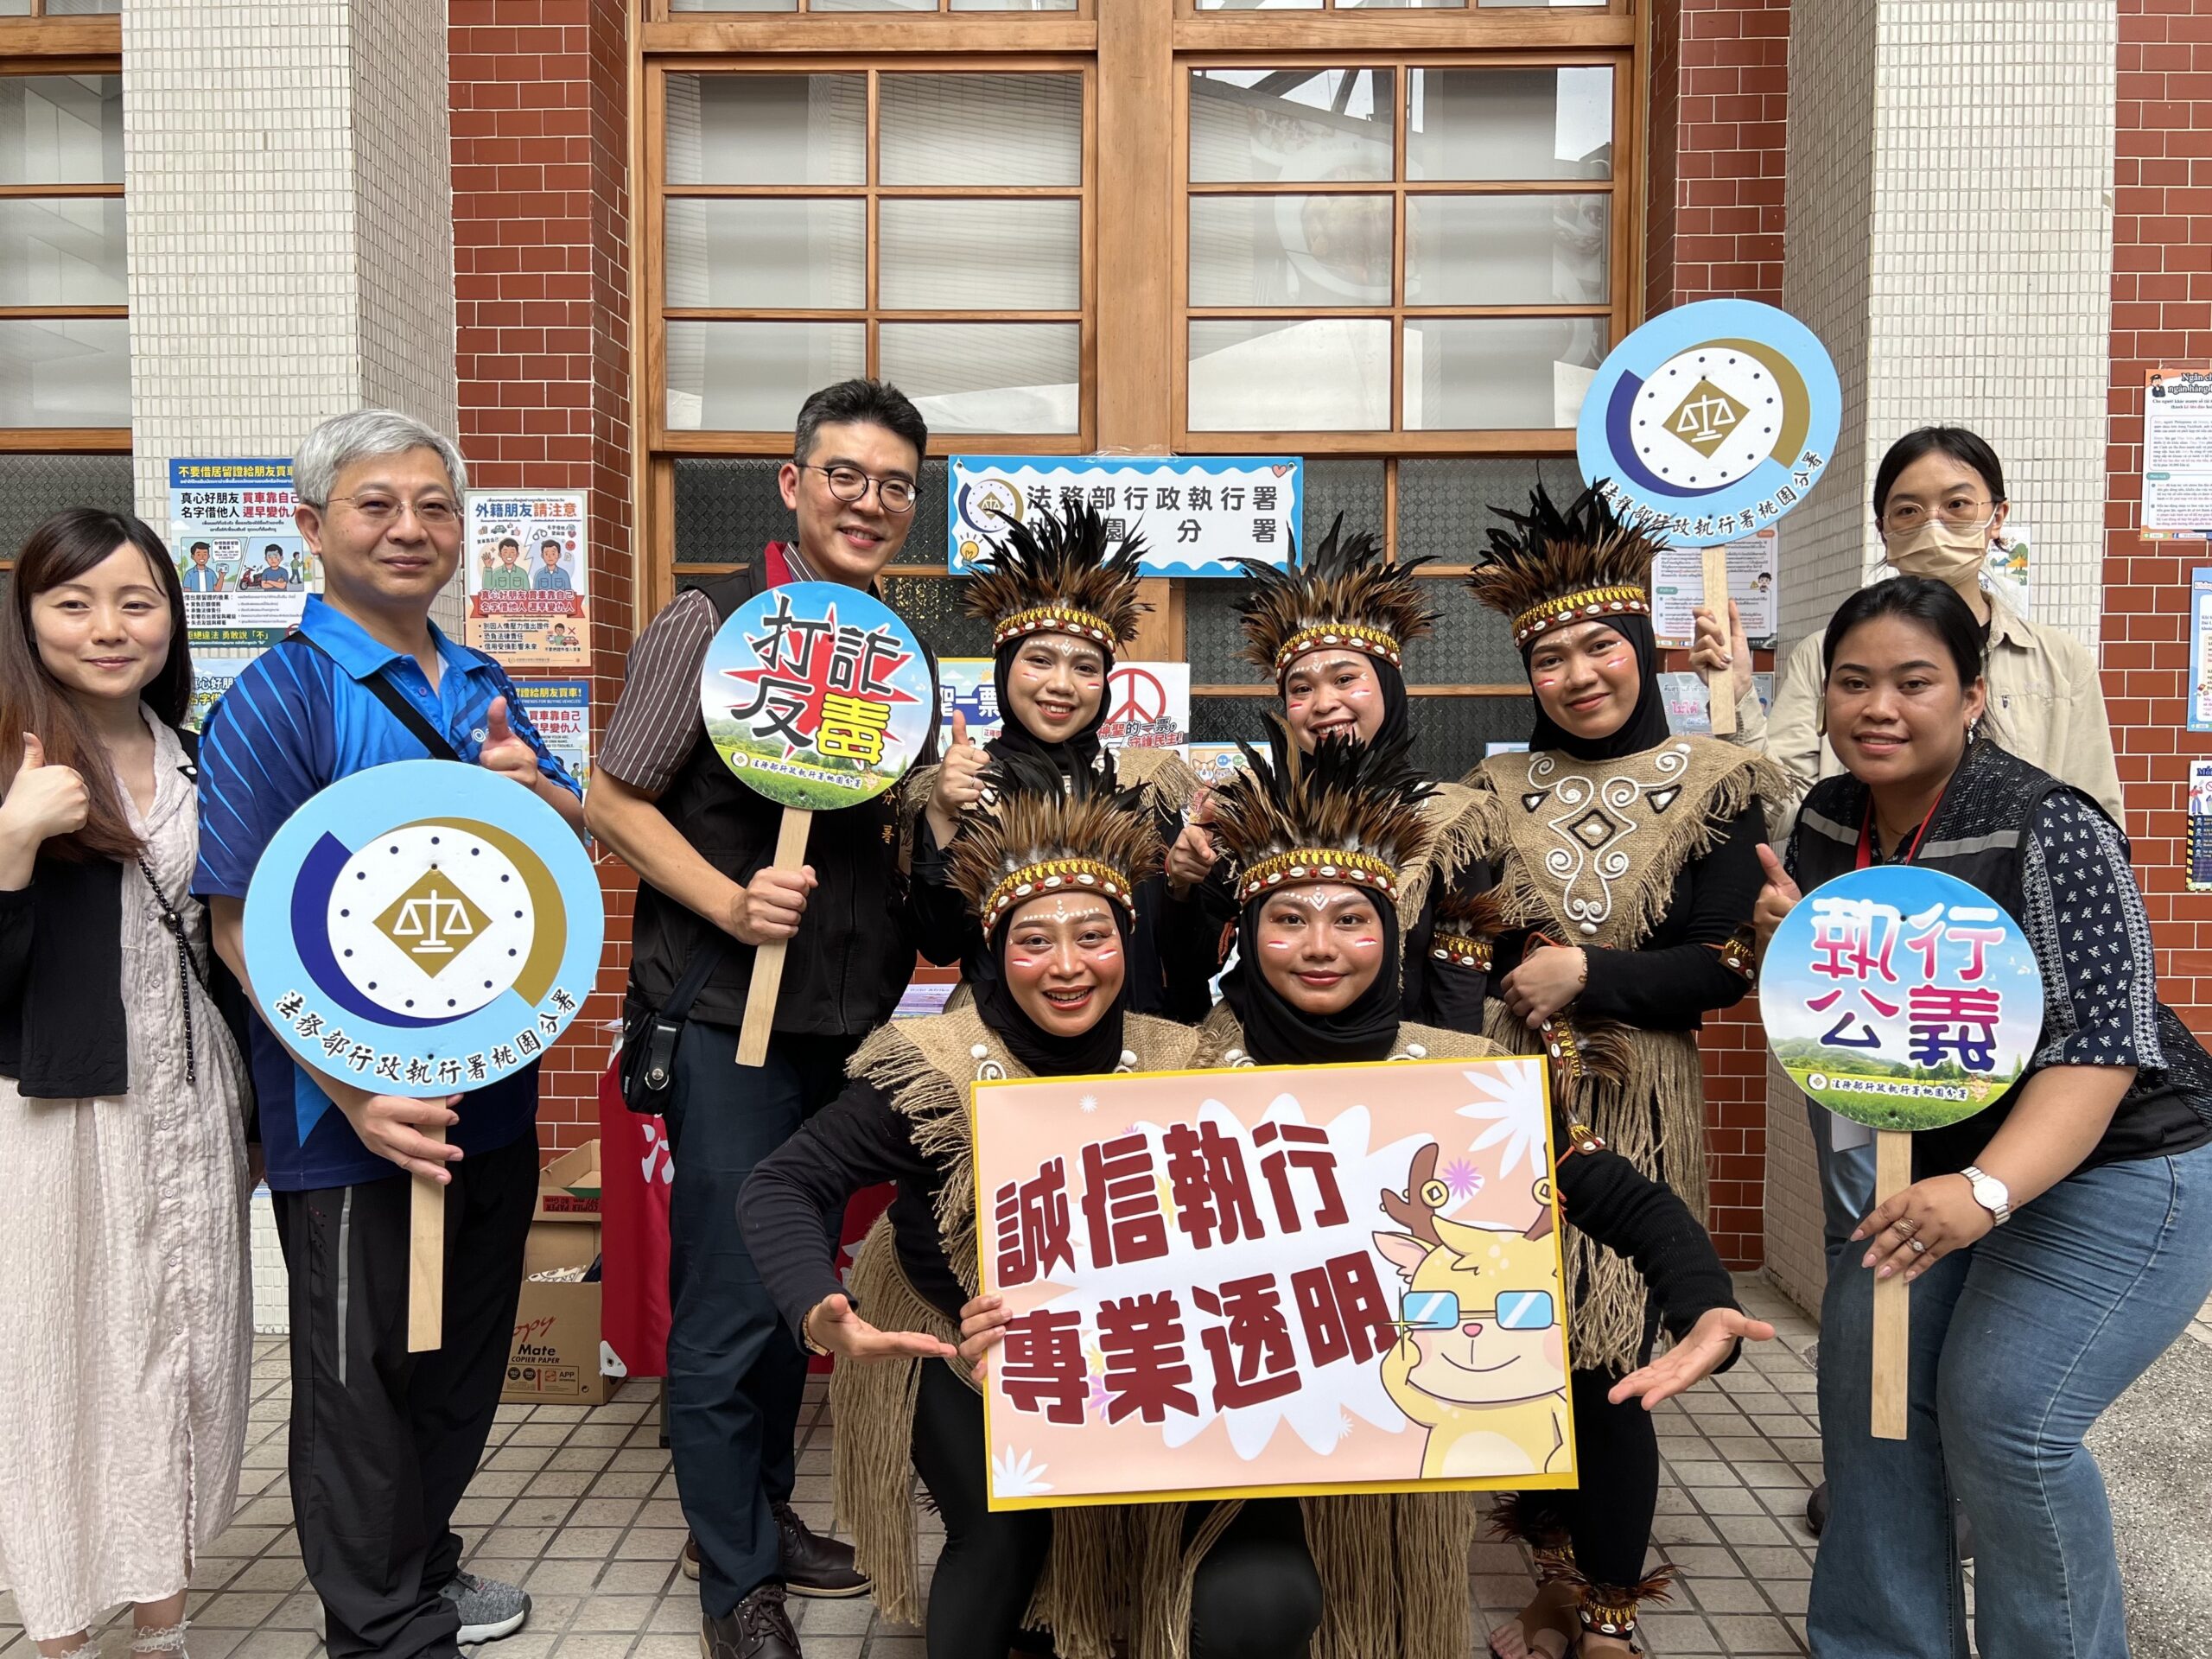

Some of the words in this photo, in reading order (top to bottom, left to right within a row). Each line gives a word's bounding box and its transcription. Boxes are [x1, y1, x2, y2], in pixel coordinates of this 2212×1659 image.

[181, 492, 239, 505] 真心好朋友
[243, 492, 300, 505] 買車靠自己
[181, 505, 240, 518] 名字借他人
[475, 503, 577, 518] 外籍朋友請注意
[1027, 486, 1278, 512] 法務部行政執行署
[480, 589, 526, 601] 真心好朋友
[529, 589, 575, 601] 買車靠自己
[480, 601, 527, 613] 名字借他人
[528, 601, 575, 613] 遲早變仇人
[751, 594, 902, 696] 打詐
[530, 710, 581, 721] 買車靠自己
[730, 676, 893, 766] 反毒
[1809, 896, 2006, 982] 執行
[274, 987, 578, 1085] 法務部行政執行署桃園分署
[1804, 984, 2001, 1071] 公義
[1831, 1078, 1969, 1101] 法務部行政執行署桃園分署
[995, 1119, 1351, 1289] 誠信執行
[512, 1315, 557, 1343] opy
[999, 1249, 1399, 1427] 專業透明
[518, 1344, 556, 1357] Mate
